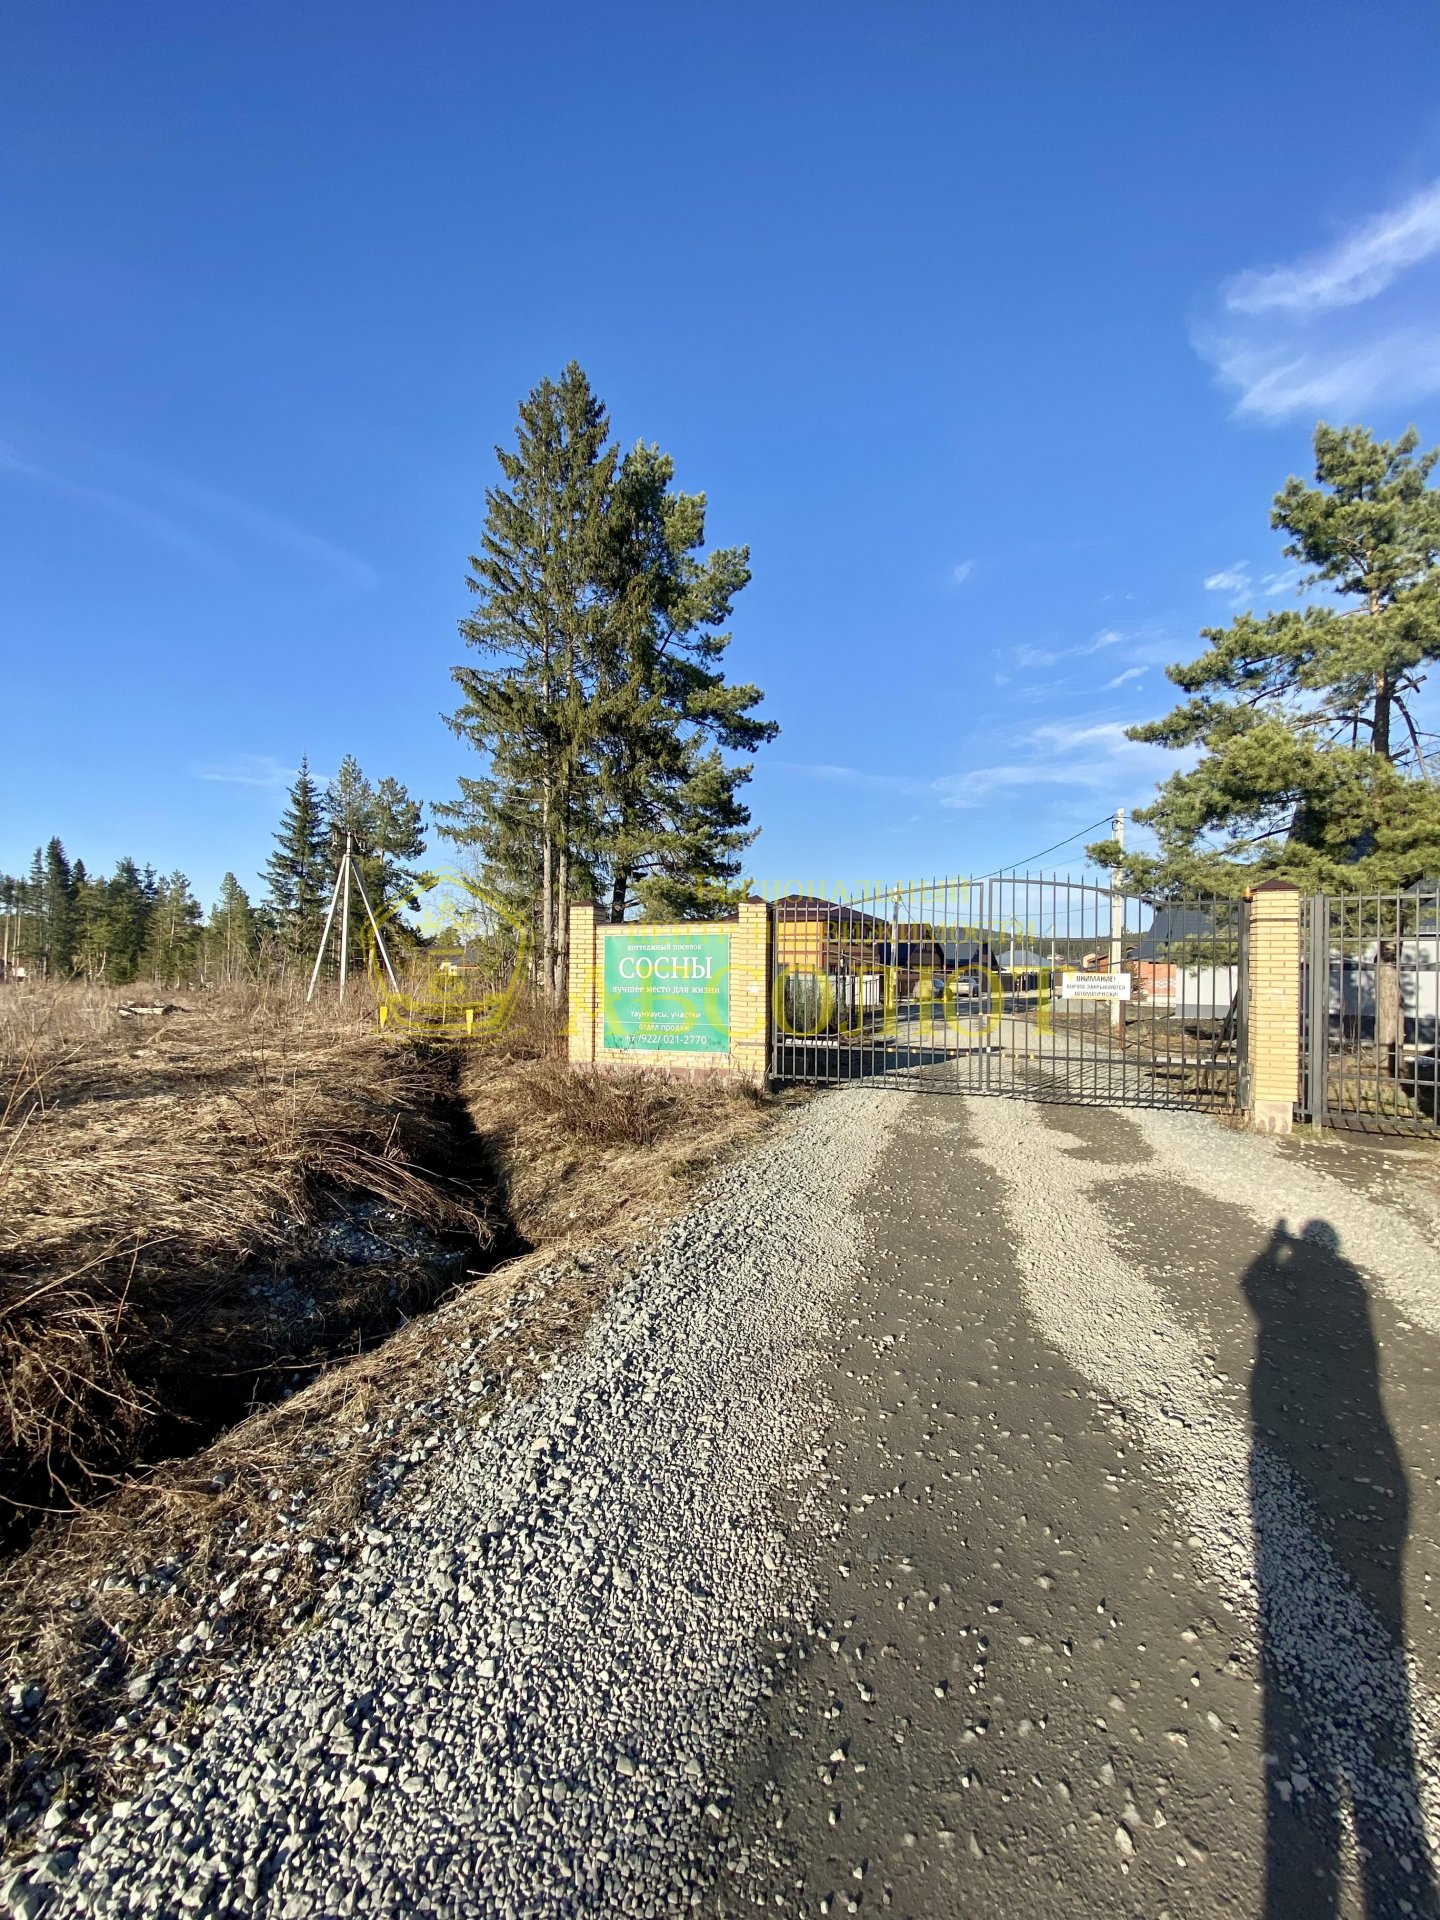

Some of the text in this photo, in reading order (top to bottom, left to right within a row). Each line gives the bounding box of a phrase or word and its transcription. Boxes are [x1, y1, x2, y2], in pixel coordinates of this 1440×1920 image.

[628, 943, 670, 951] коттеджный
[618, 957, 712, 979] СОСНЫ
[1076, 975, 1116, 983] ВНИМАНИЕ!
[612, 986, 644, 995] лучшее
[672, 986, 689, 994] для
[664, 1035, 707, 1044] 021-2770
